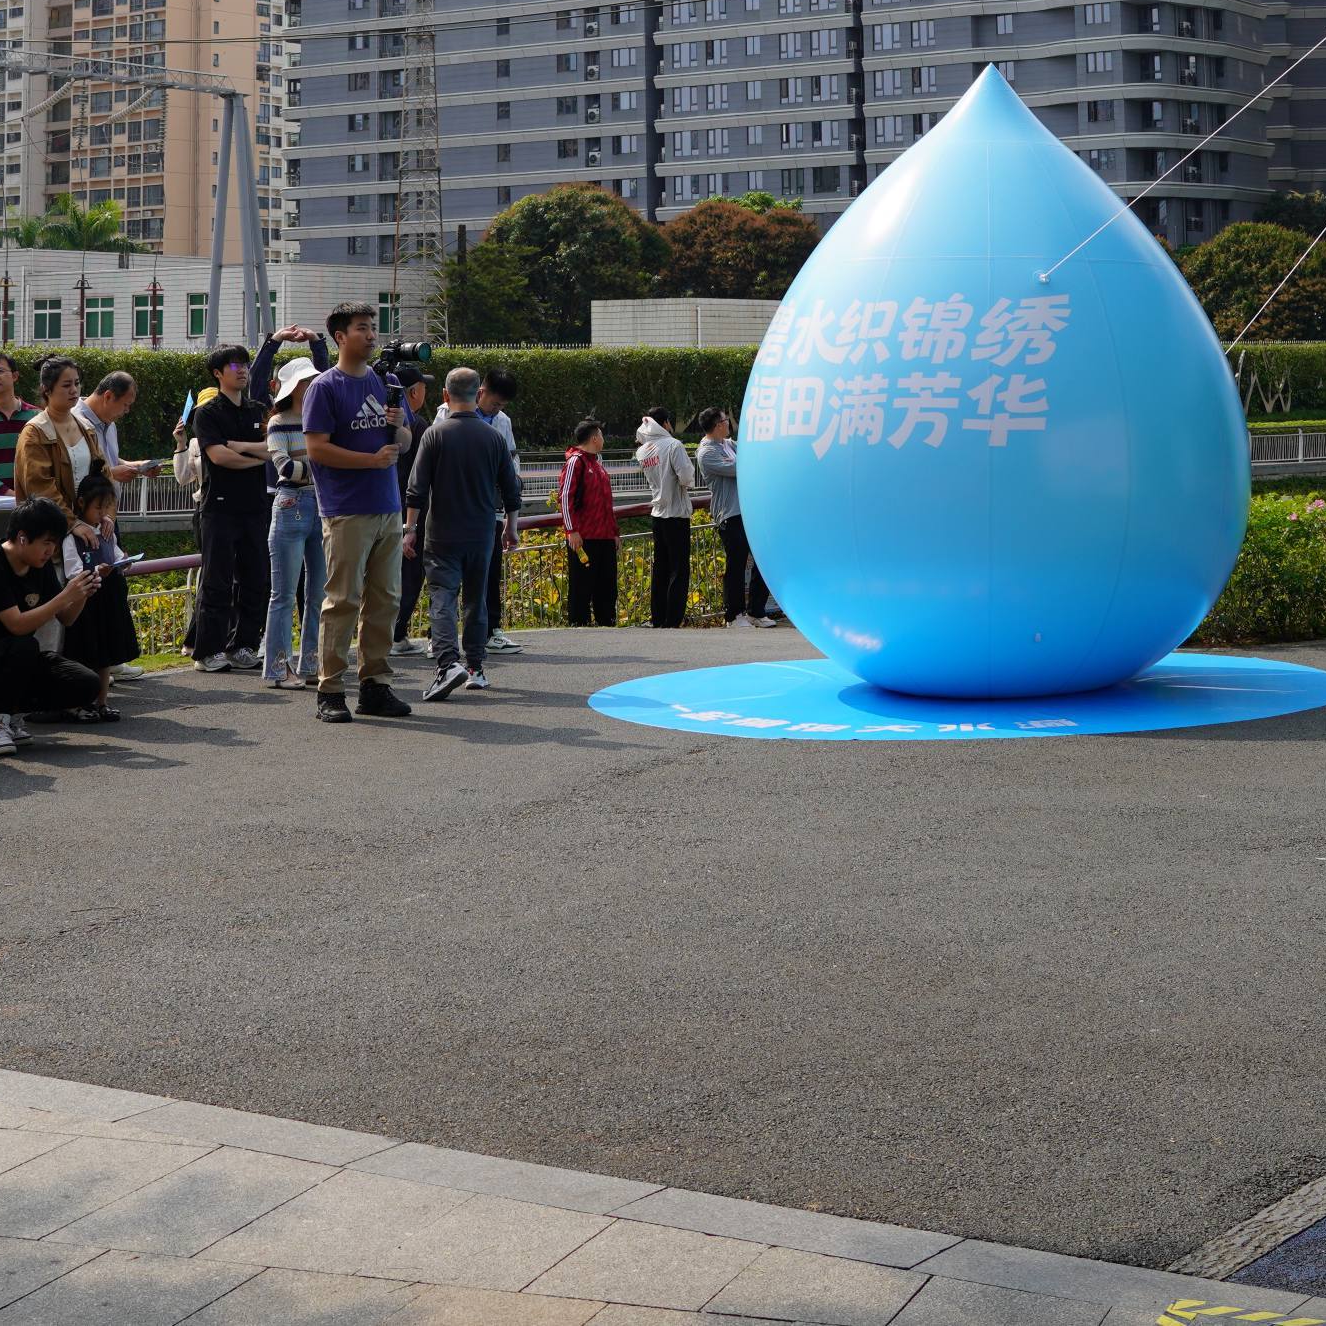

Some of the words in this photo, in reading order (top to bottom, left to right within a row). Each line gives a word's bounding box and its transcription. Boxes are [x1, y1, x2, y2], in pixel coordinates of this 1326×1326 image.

[758, 292, 1072, 367] 碧水织锦绣
[350, 414, 387, 430] adida
[746, 371, 1050, 461] 福田满芳华
